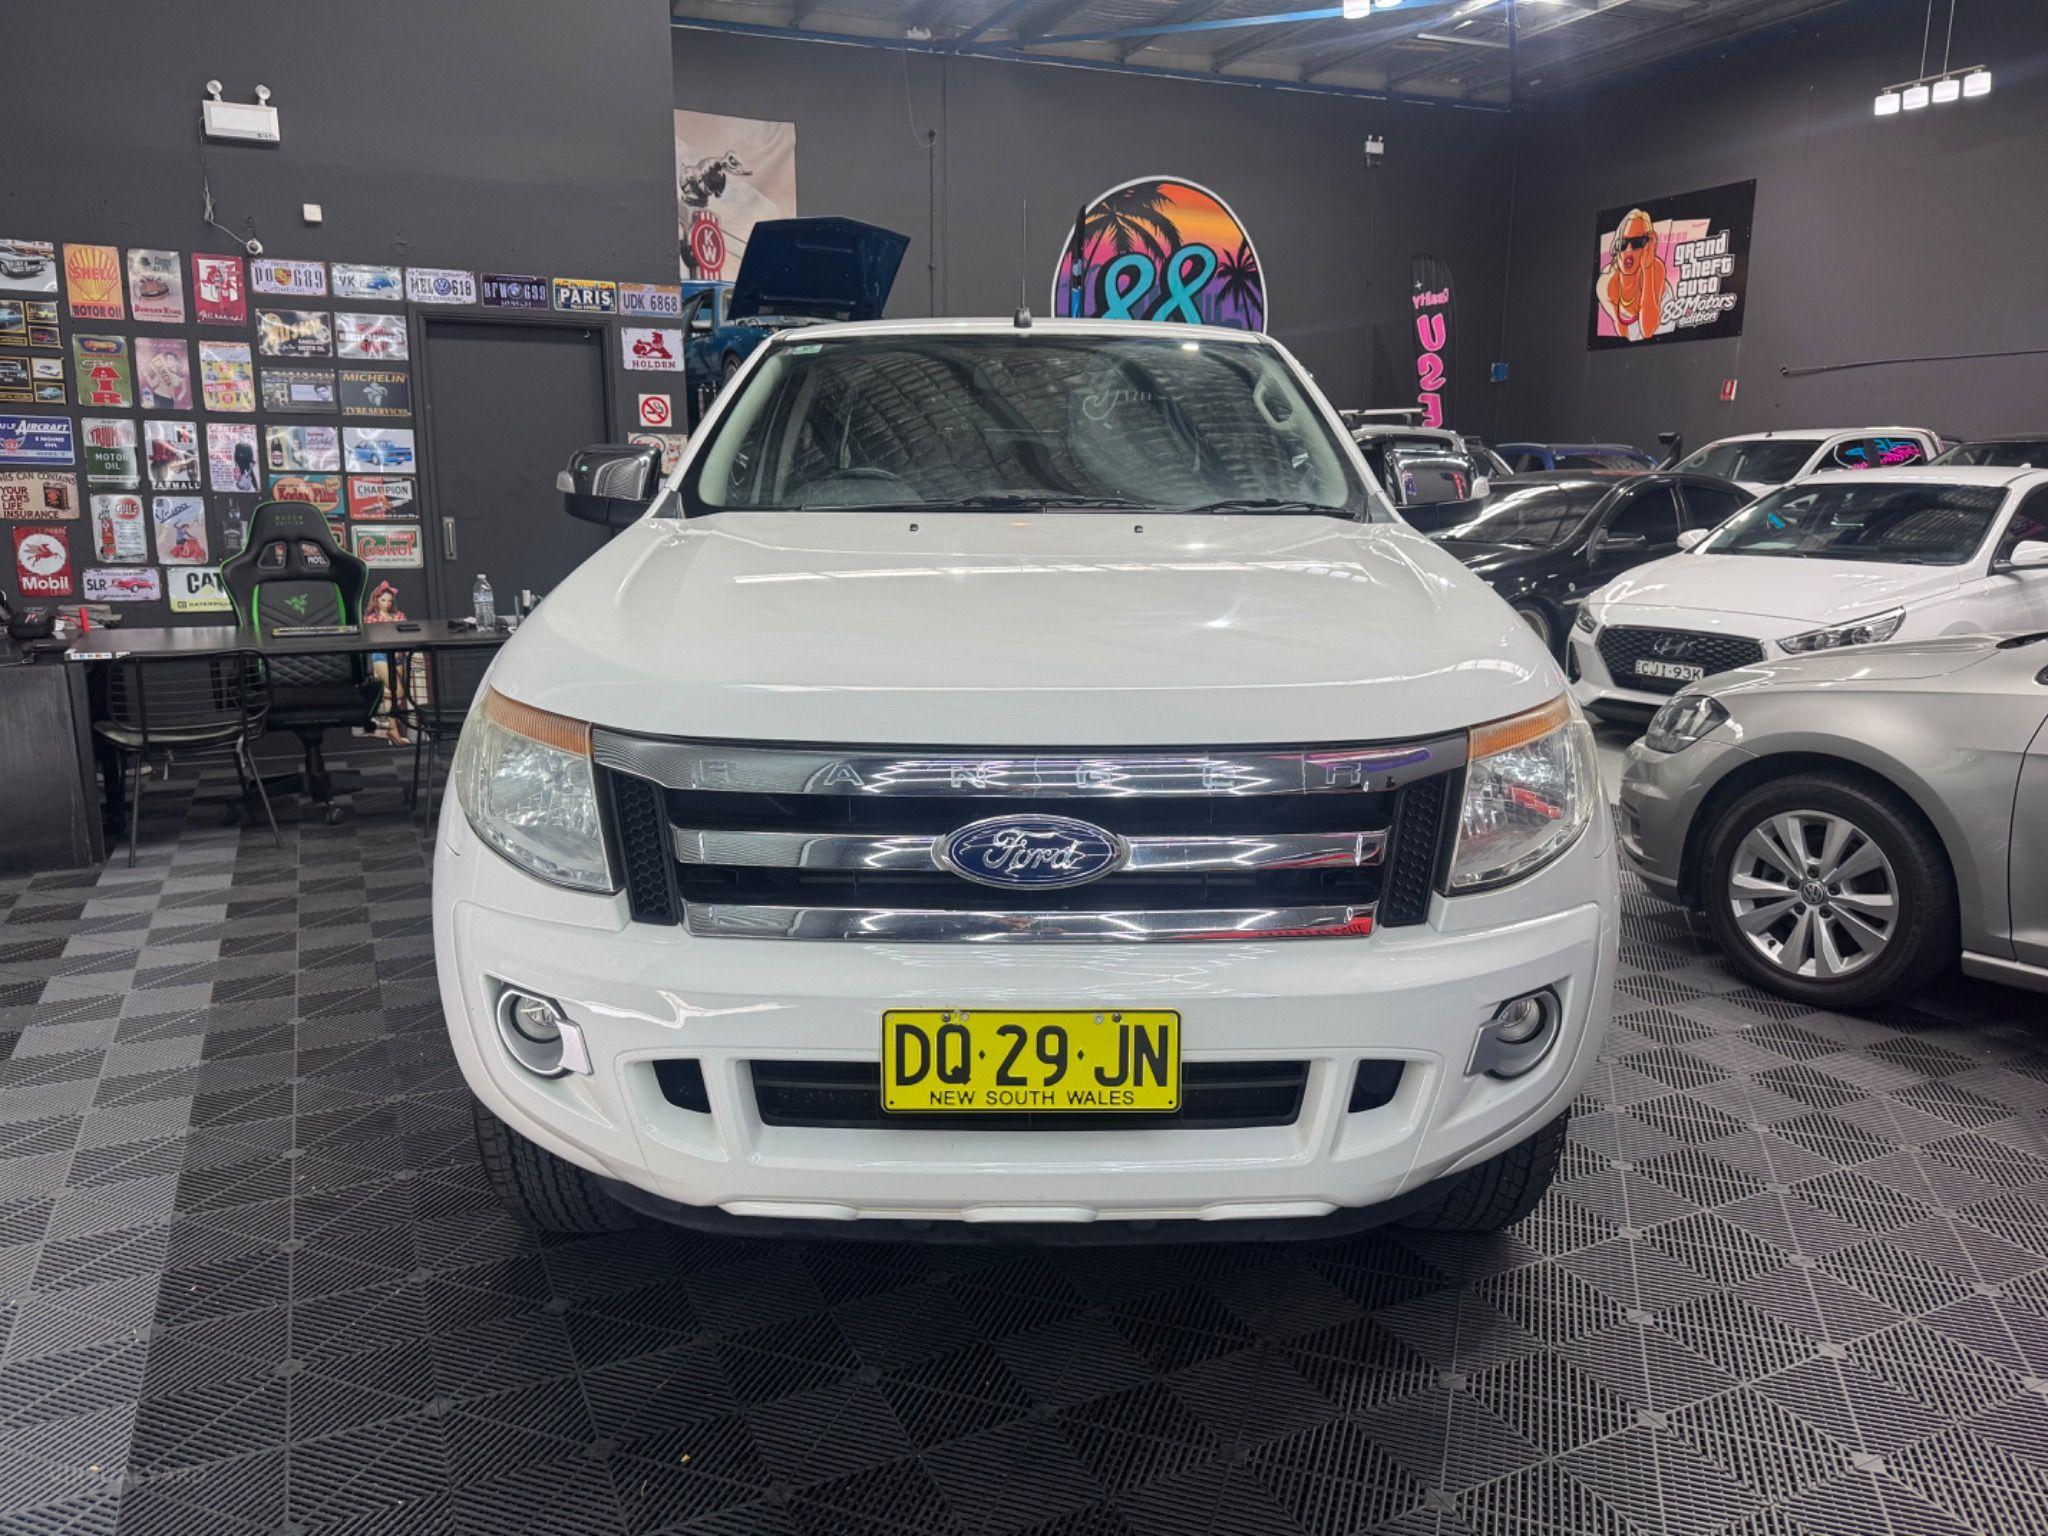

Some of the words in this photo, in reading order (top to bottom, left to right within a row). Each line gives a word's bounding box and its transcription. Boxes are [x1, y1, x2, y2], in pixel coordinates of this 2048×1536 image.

[703, 229, 713, 244] K
[702, 246, 717, 263] W
[1674, 231, 1730, 265] grand
[72, 267, 115, 280] SHELL
[1681, 256, 1733, 280] theft
[293, 270, 324, 289] 689
[1677, 277, 1720, 297] auto
[452, 280, 472, 296] 618
[559, 287, 611, 305] PARIS
[623, 293, 645, 310] UDK
[650, 295, 678, 313] 6868
[1678, 310, 1718, 326] edition
[631, 360, 677, 369] HOLDEN
[343, 373, 406, 384] MICHELIN
[16, 420, 69, 435] AIRCRAFT
[95, 453, 128, 461] MOTOR
[105, 462, 121, 470] OIL
[0, 486, 28, 494] YOUR
[2, 502, 24, 510] LIFE
[3, 510, 59, 519] INSURANCE
[358, 535, 416, 562] Castrol
[22, 576, 70, 590] Mobil
[86, 579, 107, 591] SLR
[186, 571, 224, 594] CAT
[703, 757, 1362, 789] RANGER
[983, 829, 1085, 877] Ford
[930, 1090, 975, 1105] NEW
[986, 1090, 1055, 1105] SOUTH
[1067, 1090, 1134, 1106] WALES
